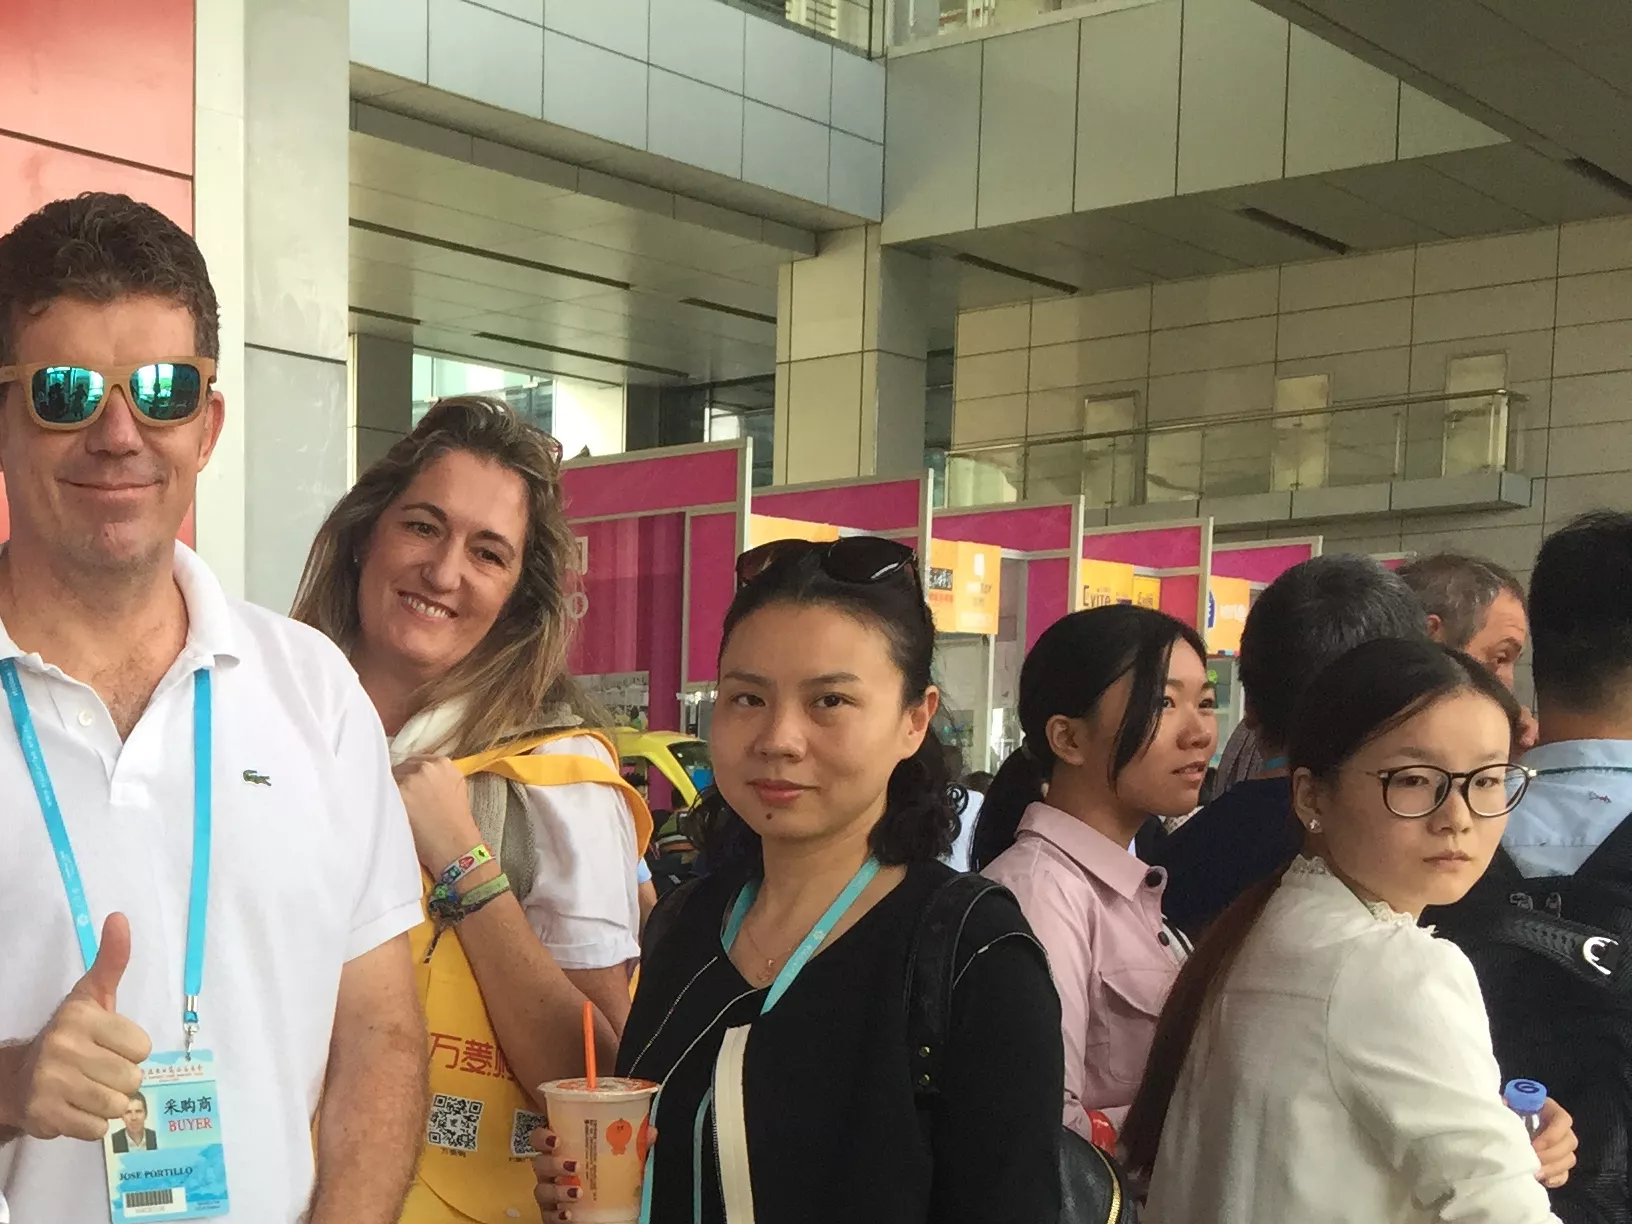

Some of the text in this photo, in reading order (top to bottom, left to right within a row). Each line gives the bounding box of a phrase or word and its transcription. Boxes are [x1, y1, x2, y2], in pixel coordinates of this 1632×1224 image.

[164, 1096, 212, 1115] 采购商
[169, 1118, 212, 1132] BUYER
[119, 1167, 193, 1181] JOSE PORTILLO
